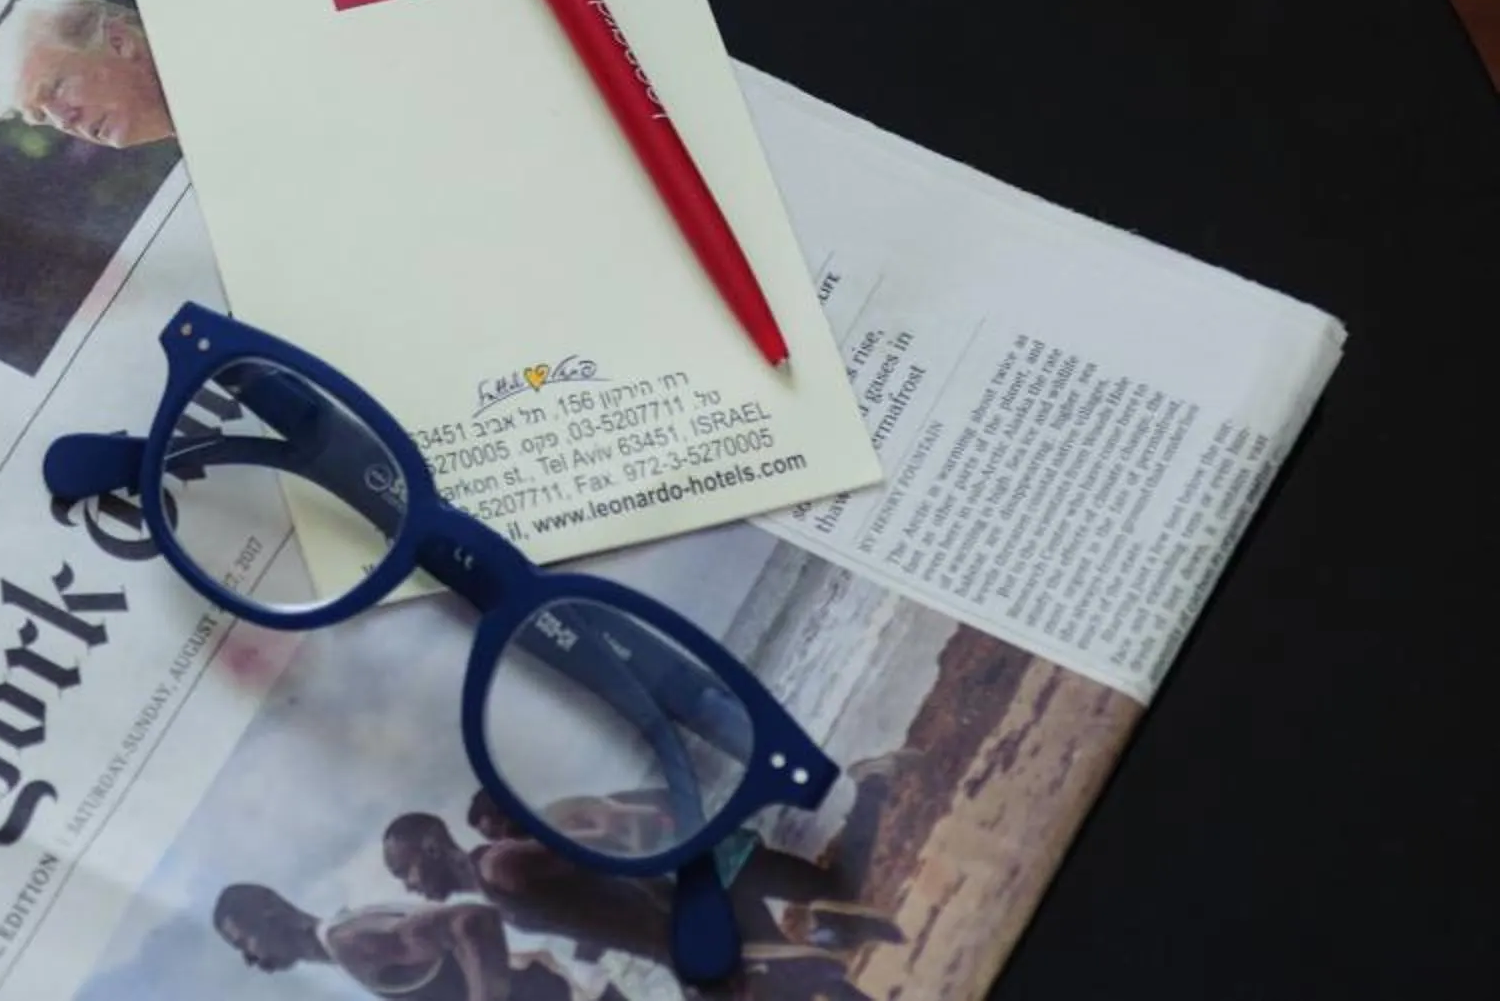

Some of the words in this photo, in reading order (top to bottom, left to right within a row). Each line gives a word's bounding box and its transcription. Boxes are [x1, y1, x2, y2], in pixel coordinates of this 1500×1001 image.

[850, 327, 885, 367] rise,
[861, 352, 903, 405] gases
[887, 326, 915, 353] in
[470, 414, 517, 438] אביב
[517, 406, 547, 424] תל
[601, 380, 654, 411] הירקון
[868, 364, 925, 452] ermafrost
[411, 423, 467, 449] 3451
[440, 475, 499, 501] arkon
[536, 453, 569, 476] Tel
[573, 446, 613, 468] Aviv
[690, 401, 773, 436] ISRAEL
[622, 427, 775, 483] 972-3-5270005
[532, 454, 808, 534] www.leonardo-hotels.com
[856, 532, 878, 555] BY
[867, 486, 906, 535] HENRY
[894, 417, 947, 489] FOUNTAIN
[62, 675, 178, 839] SATURDAY-SUNDAY,
[165, 610, 219, 679] AUGUST
[232, 533, 266, 572] 2017
